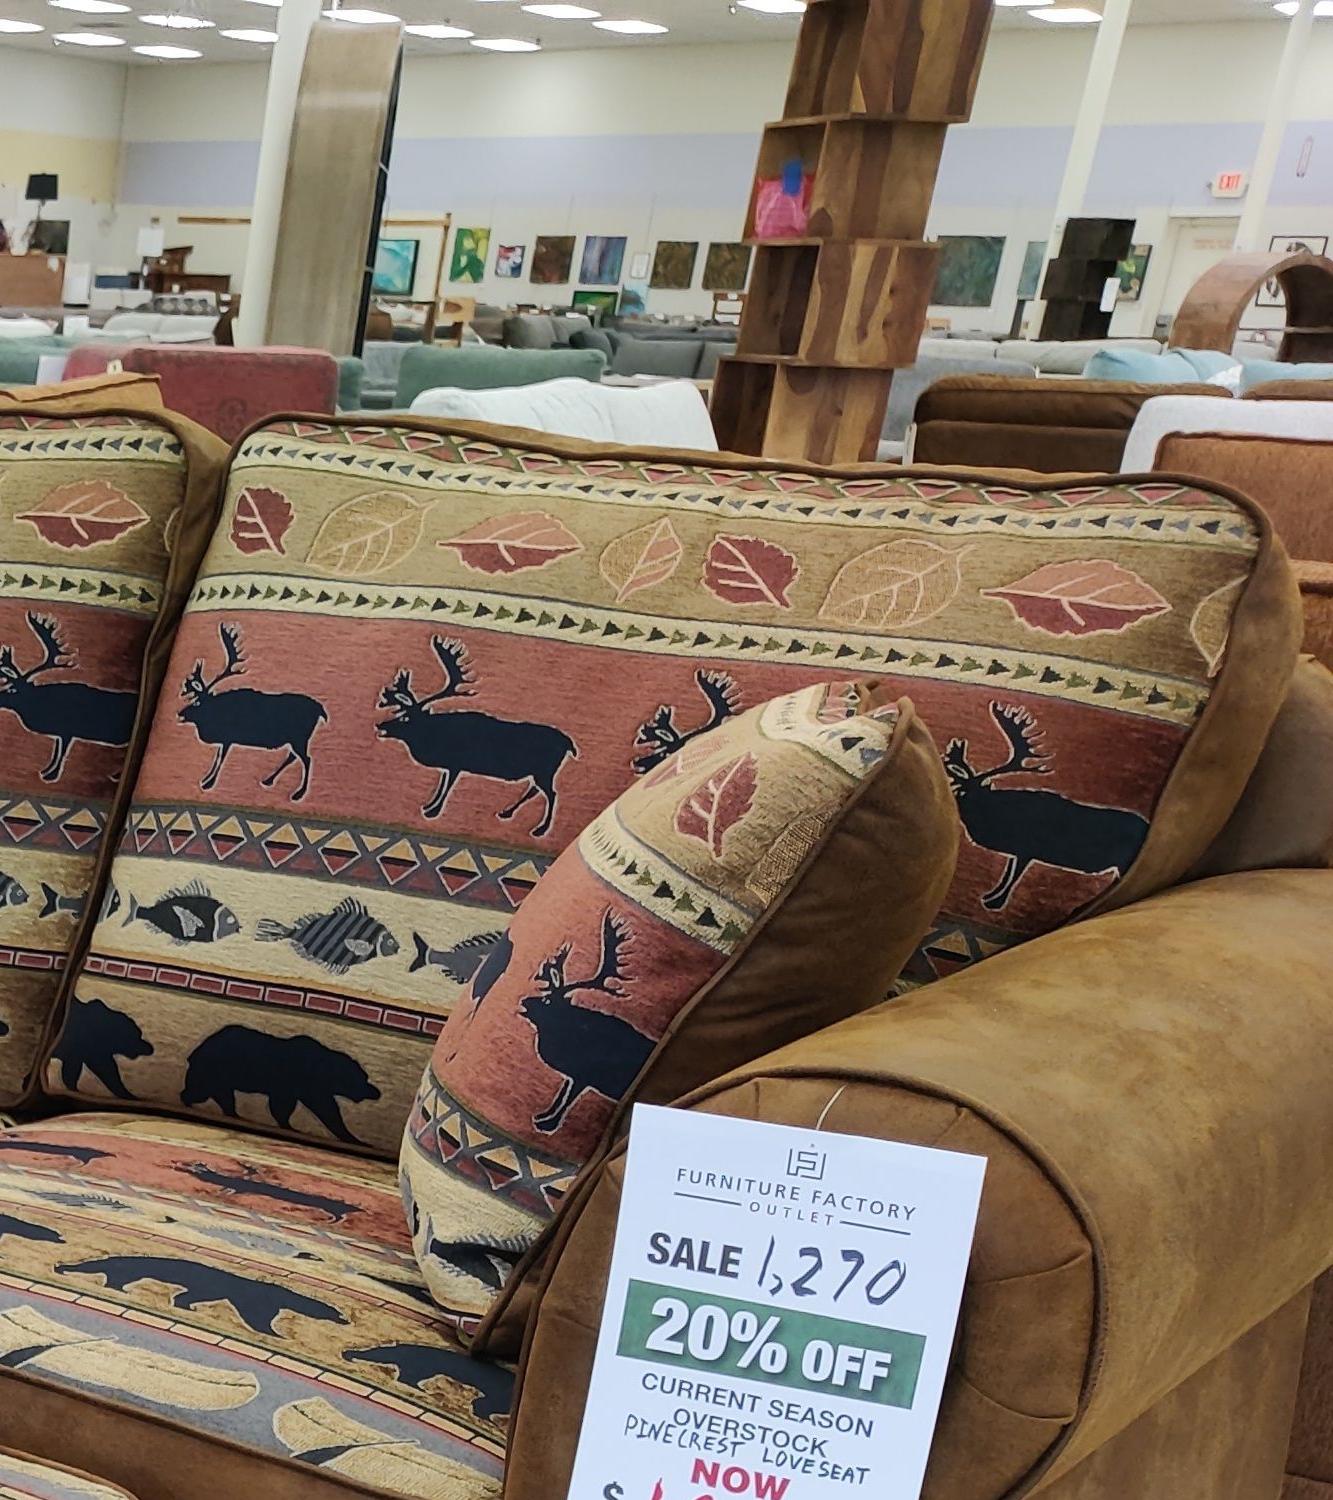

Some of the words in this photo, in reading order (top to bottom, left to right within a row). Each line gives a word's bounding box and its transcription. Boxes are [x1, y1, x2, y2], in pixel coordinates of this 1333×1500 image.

[677, 1167, 800, 1202] FURNITURE
[812, 1189, 917, 1222] FACTORY
[749, 1201, 835, 1227] OUTLET
[647, 1232, 743, 1279] SALE
[757, 1235, 907, 1306] 1,270
[645, 1297, 788, 1375] 20%
[801, 1339, 893, 1392] OFF
[641, 1373, 762, 1413] CURRENT
[768, 1398, 874, 1438] SEASON
[673, 1408, 830, 1458] OVERSTOCK
[624, 1413, 746, 1458] PINECREST
